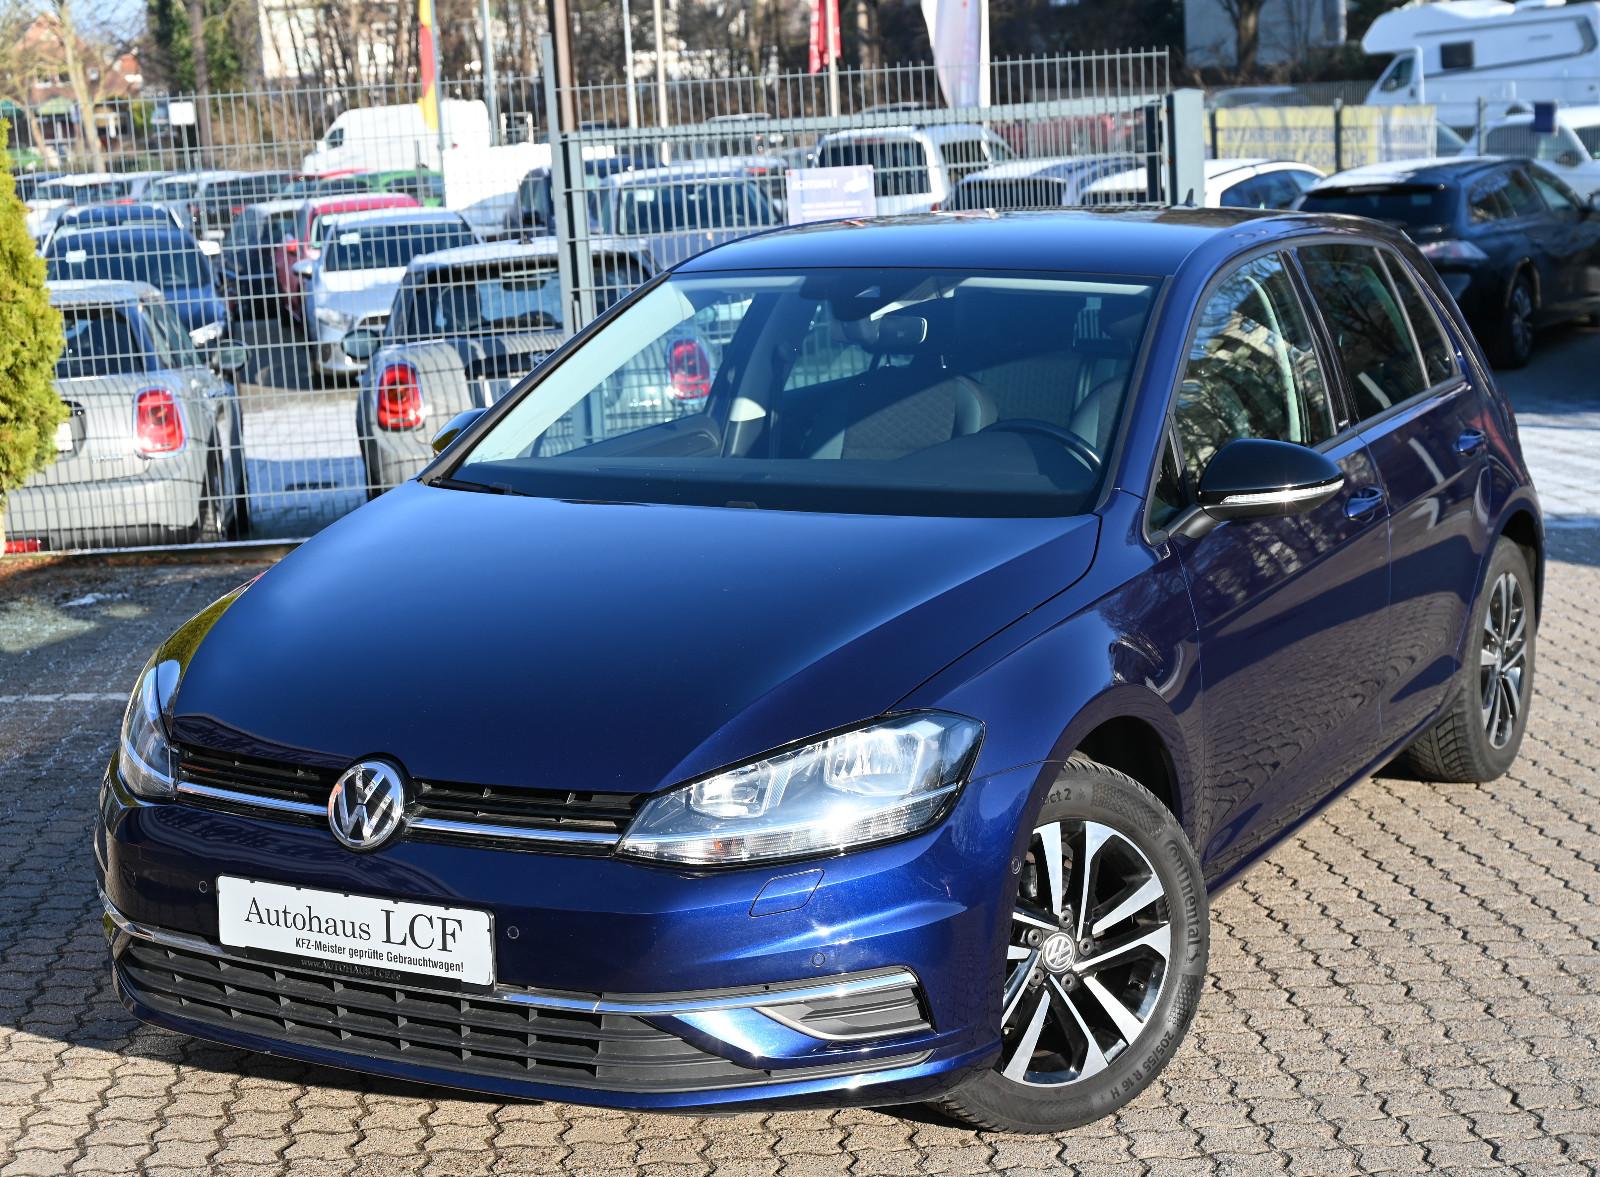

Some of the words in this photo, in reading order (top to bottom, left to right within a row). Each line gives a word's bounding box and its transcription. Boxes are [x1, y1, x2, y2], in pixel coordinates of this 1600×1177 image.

[328, 762, 403, 848] VW
[1063, 787, 1072, 801] 2
[1164, 839, 1202, 946] Continental
[244, 897, 371, 941] Autohaus
[380, 908, 463, 953] LCF
[295, 937, 346, 956] KFZ-Meister
[348, 947, 384, 963] geprüfte
[386, 951, 465, 973] Gebrauchtwagen!
[1042, 932, 1075, 972] VW
[1141, 1030, 1175, 1073] 205/55
[1110, 1086, 1121, 1100] H
[1121, 1077, 1135, 1092] 16
[1132, 1070, 1143, 1081] R
